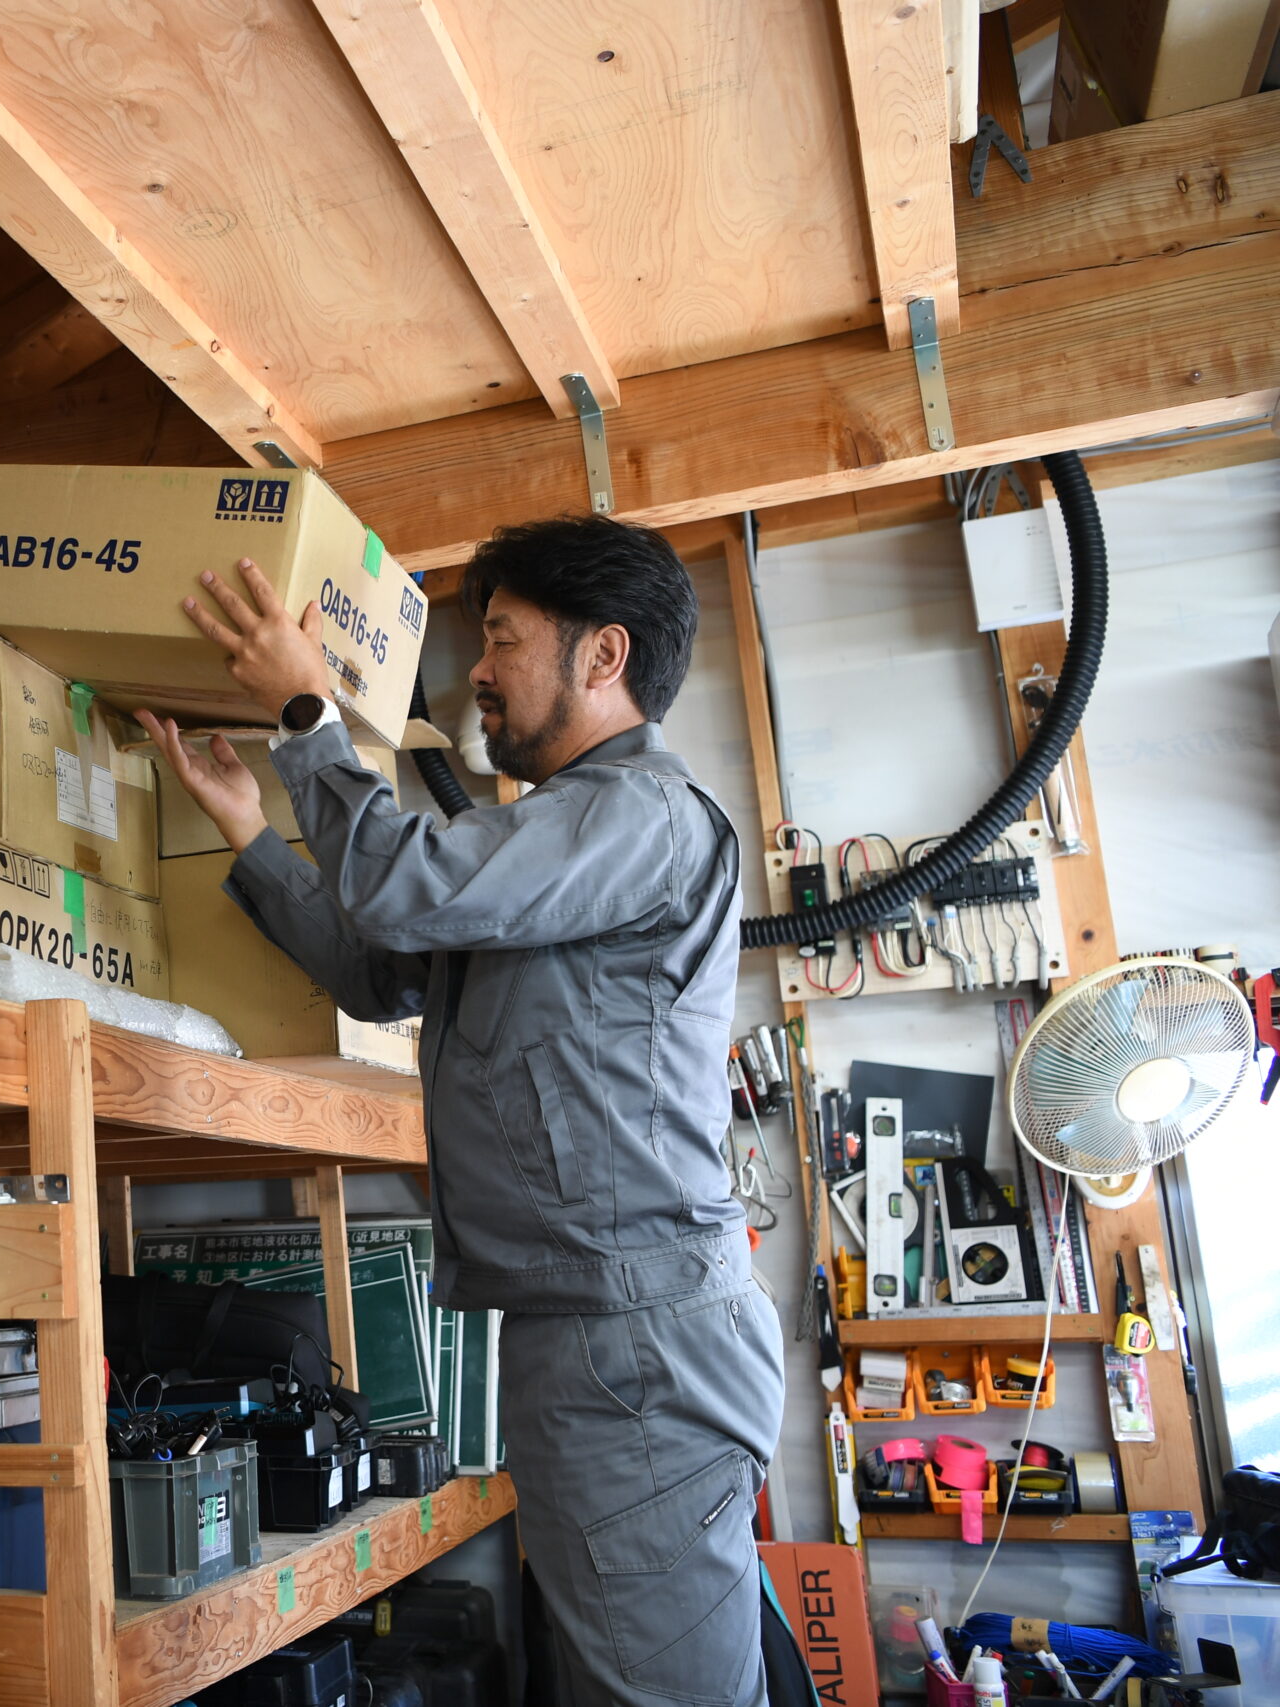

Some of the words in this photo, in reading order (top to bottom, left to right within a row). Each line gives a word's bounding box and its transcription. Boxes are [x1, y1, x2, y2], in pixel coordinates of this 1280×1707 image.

[321, 577, 388, 665] OAB16-45
[144, 1244, 189, 1260] 工事名
[801, 1569, 847, 1706] ALIPER
